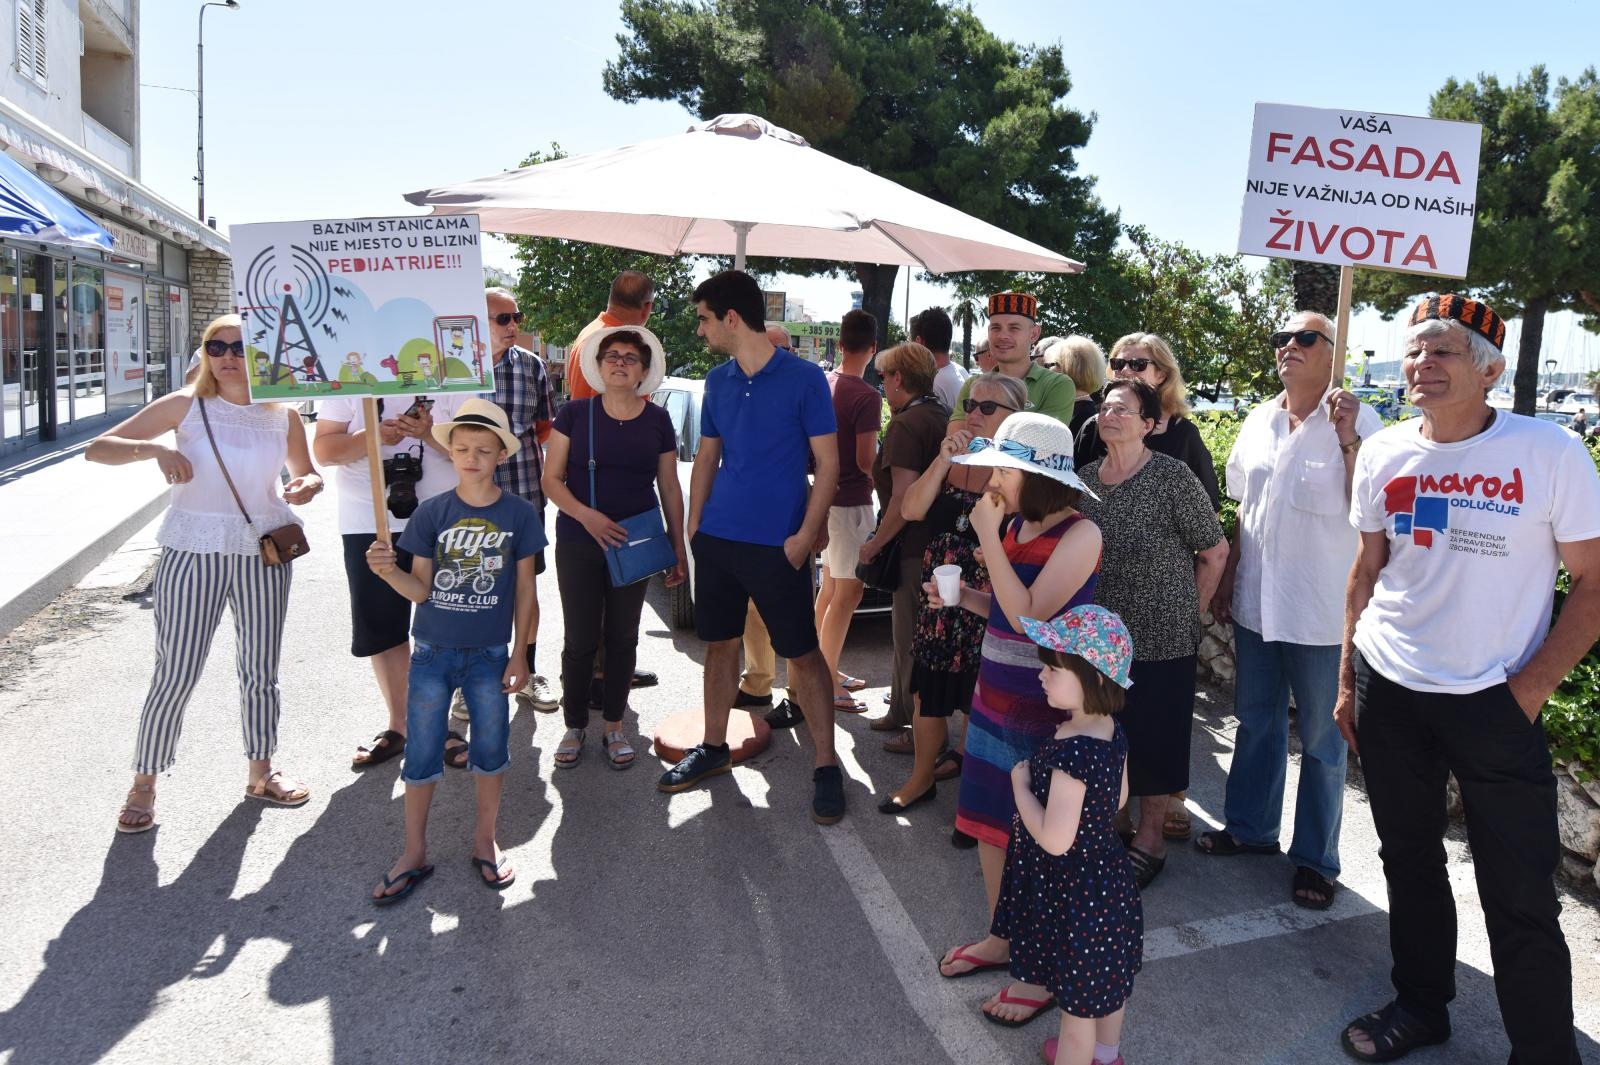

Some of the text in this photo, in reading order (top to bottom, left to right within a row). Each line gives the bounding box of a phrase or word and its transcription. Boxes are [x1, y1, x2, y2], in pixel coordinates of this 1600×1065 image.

[1340, 115, 1392, 135] VAŠA
[1266, 132, 1461, 184] FASADA
[1246, 179, 1474, 217] NIJE VAŽNIJA OD NAŠIH
[313, 217, 470, 235] BAZNIM STANICAMA
[309, 234, 478, 252] NIJE MJESTO U BLIZINI
[1265, 208, 1438, 270] ŽIVOTA
[328, 254, 462, 273] PEDIJATRIJE!!!
[824, 327, 834, 336] 99
[1419, 467, 1524, 505] narod
[1450, 498, 1521, 516] ODLUČUJE
[437, 526, 514, 557] Flyer
[1449, 535, 1458, 543] ZA
[1450, 528, 1506, 542] REFERENDUM
[1480, 549, 1510, 557] SUSTAV
[428, 590, 466, 604] UROPE
[468, 594, 499, 605] CLUB
